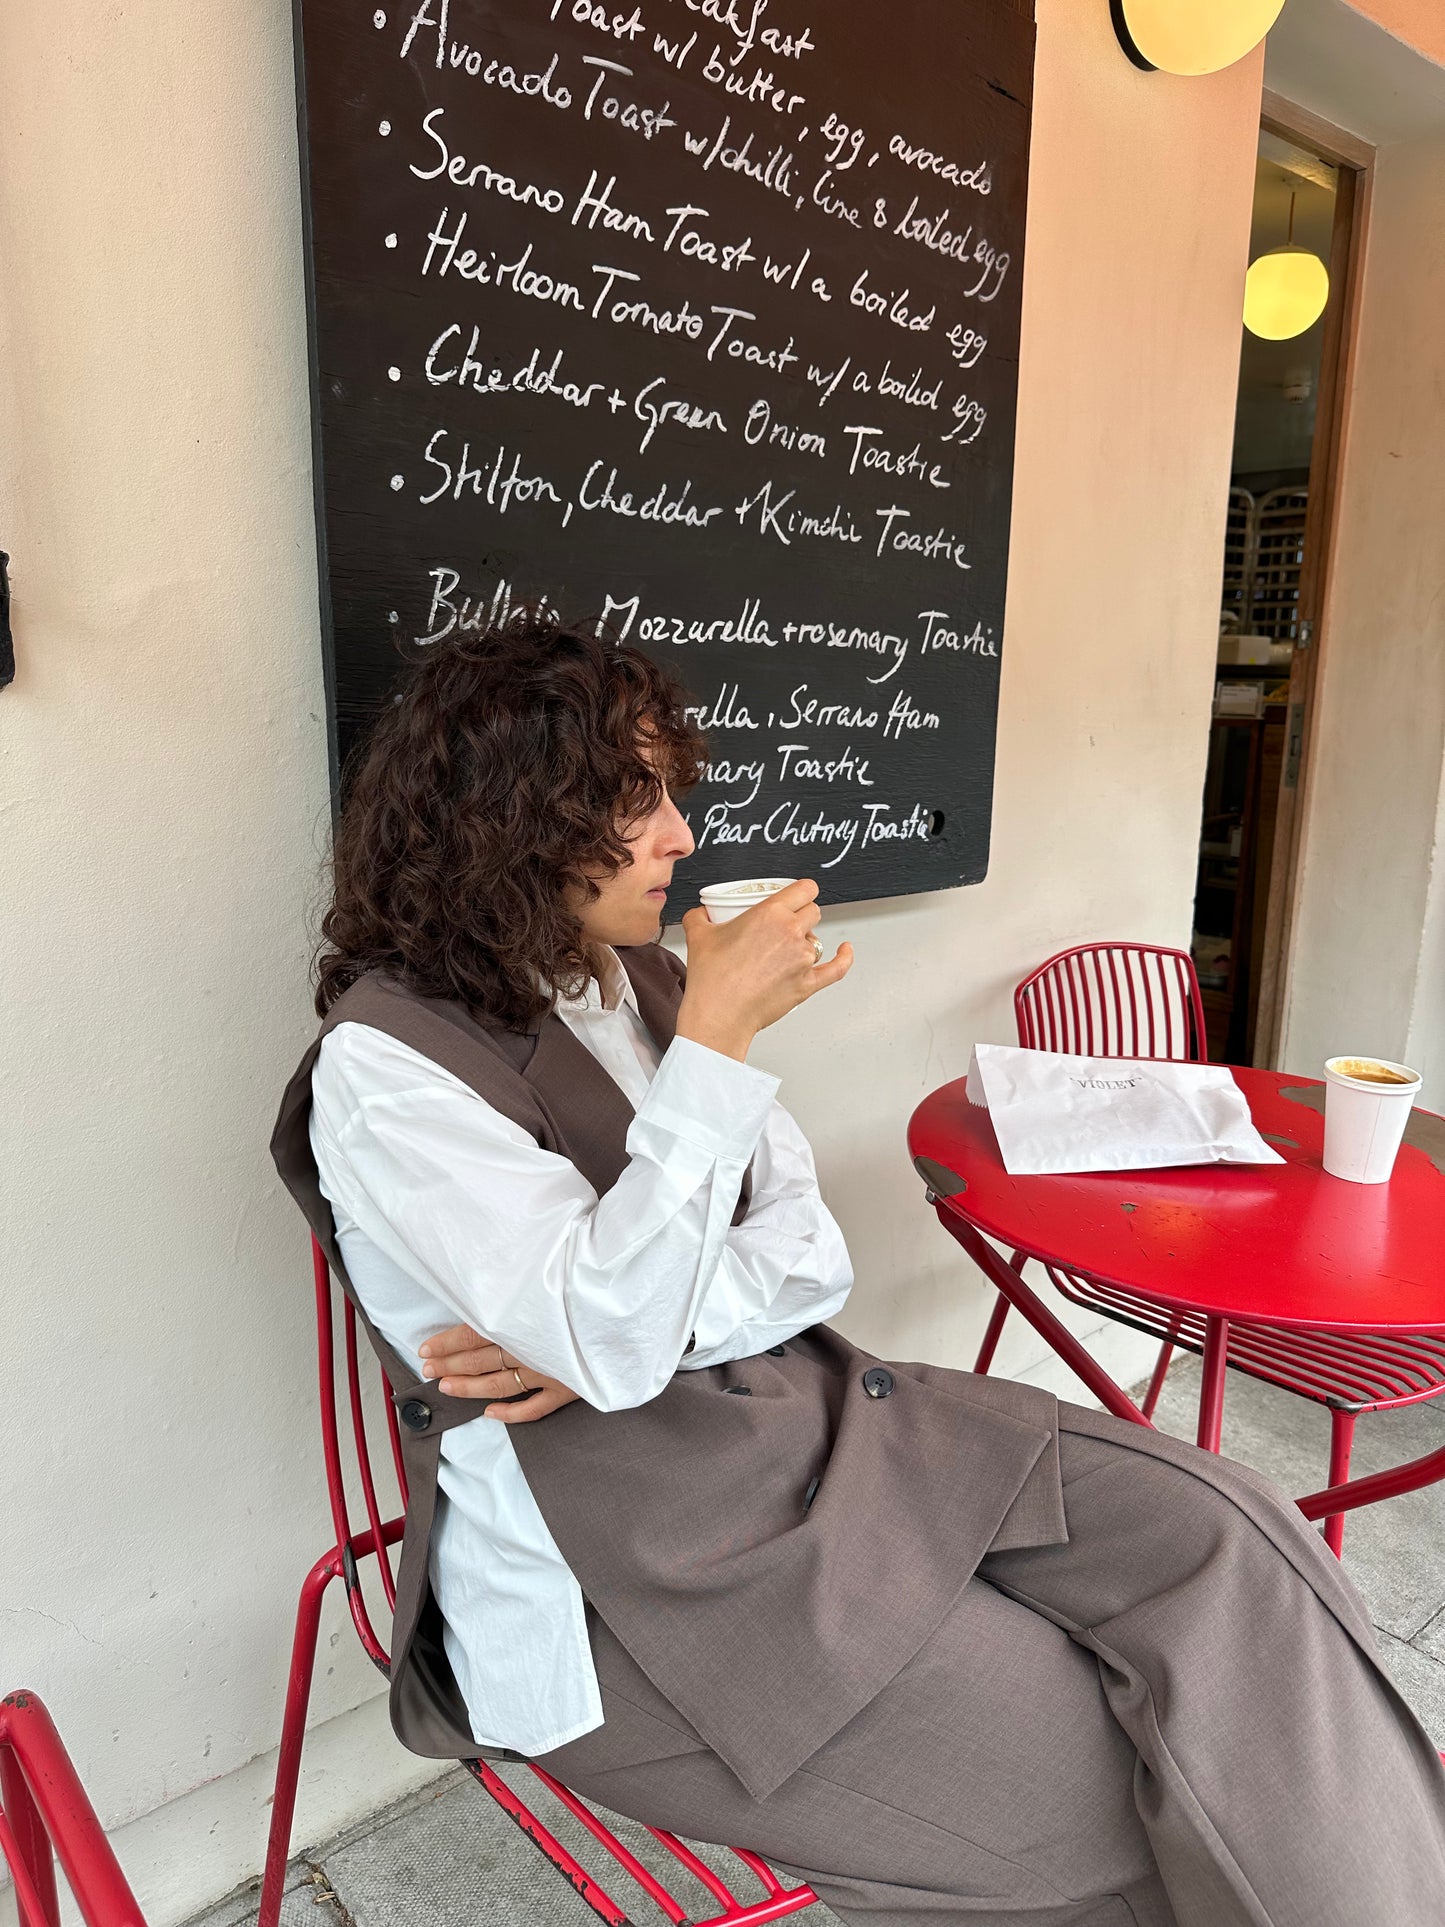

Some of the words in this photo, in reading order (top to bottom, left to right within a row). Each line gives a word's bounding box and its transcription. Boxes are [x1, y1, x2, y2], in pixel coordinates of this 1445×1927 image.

[400, 0, 572, 109] Avocado
[582, 54, 678, 140] Toast
[963, 238, 1011, 300] egg
[888, 134, 992, 196] avocado
[409, 107, 564, 213] Serrano
[571, 169, 655, 242] Ham
[665, 203, 756, 272] Toast
[811, 278, 832, 301] a
[850, 269, 936, 331] boiled
[946, 324, 988, 369] egg
[421, 206, 585, 311] Heirloom
[592, 264, 704, 340] Tomato
[706, 305, 799, 373] Toast
[878, 360, 943, 411] boiled
[940, 394, 988, 445] egg
[424, 323, 606, 407] Cheddar
[635, 376, 727, 455] Green
[744, 399, 826, 458] Onion
[843, 425, 951, 488] Toastie
[578, 459, 724, 527] Cheddar
[876, 504, 972, 569] Toastie
[594, 593, 779, 648] Mozzarella
[918, 610, 998, 657] Toastie
[779, 684, 879, 729] Serrano
[883, 689, 940, 739] Ham
[777, 744, 875, 786] Toastie
[698, 803, 762, 849] Pear
[763, 801, 859, 868] Chutney
[861, 802, 930, 848] Toastie
[1079, 1079, 1136, 1090] VIOLET
